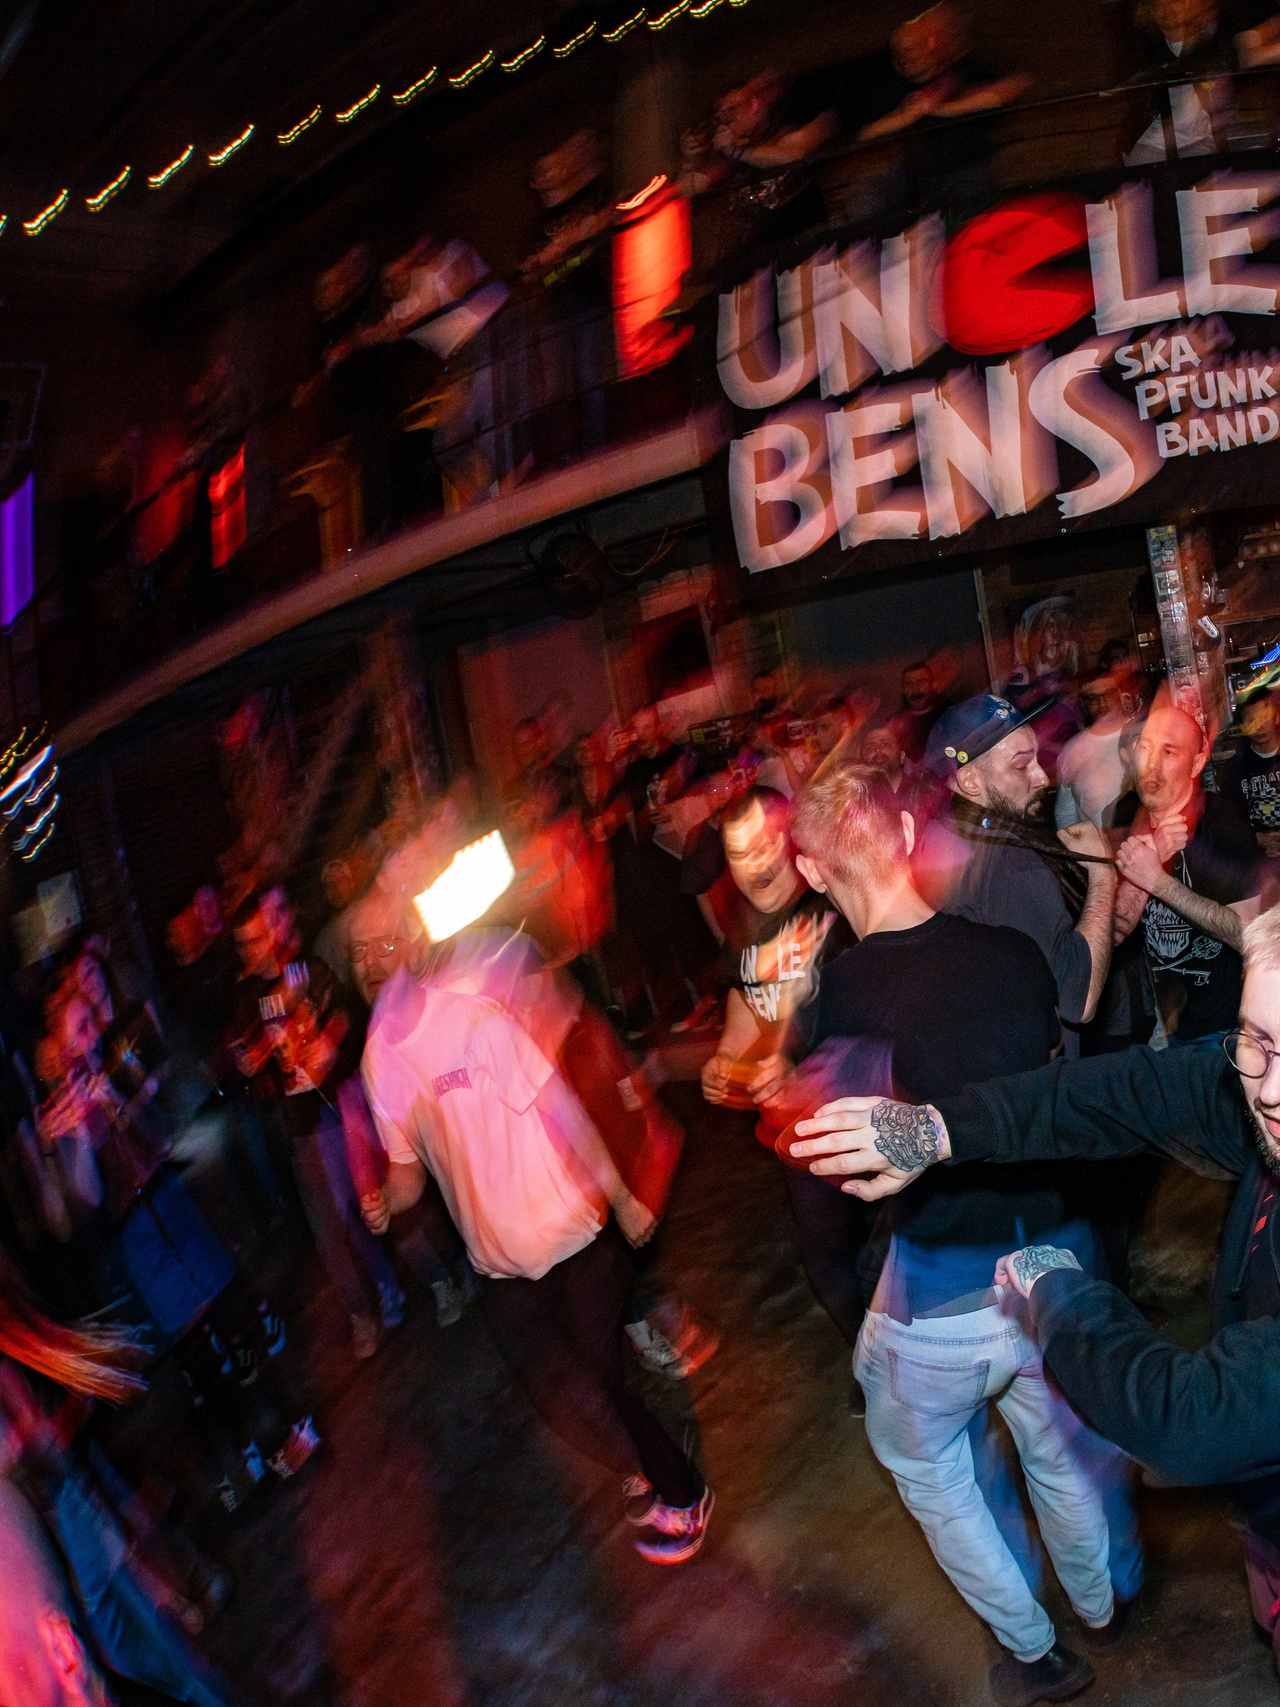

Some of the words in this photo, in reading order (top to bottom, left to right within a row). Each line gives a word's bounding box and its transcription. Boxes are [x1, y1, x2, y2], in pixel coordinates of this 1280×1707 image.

[1114, 335, 1202, 381] SKA
[1135, 365, 1278, 421] PFUNK
[1156, 406, 1280, 458] BAND
[728, 348, 1136, 574] BENS
